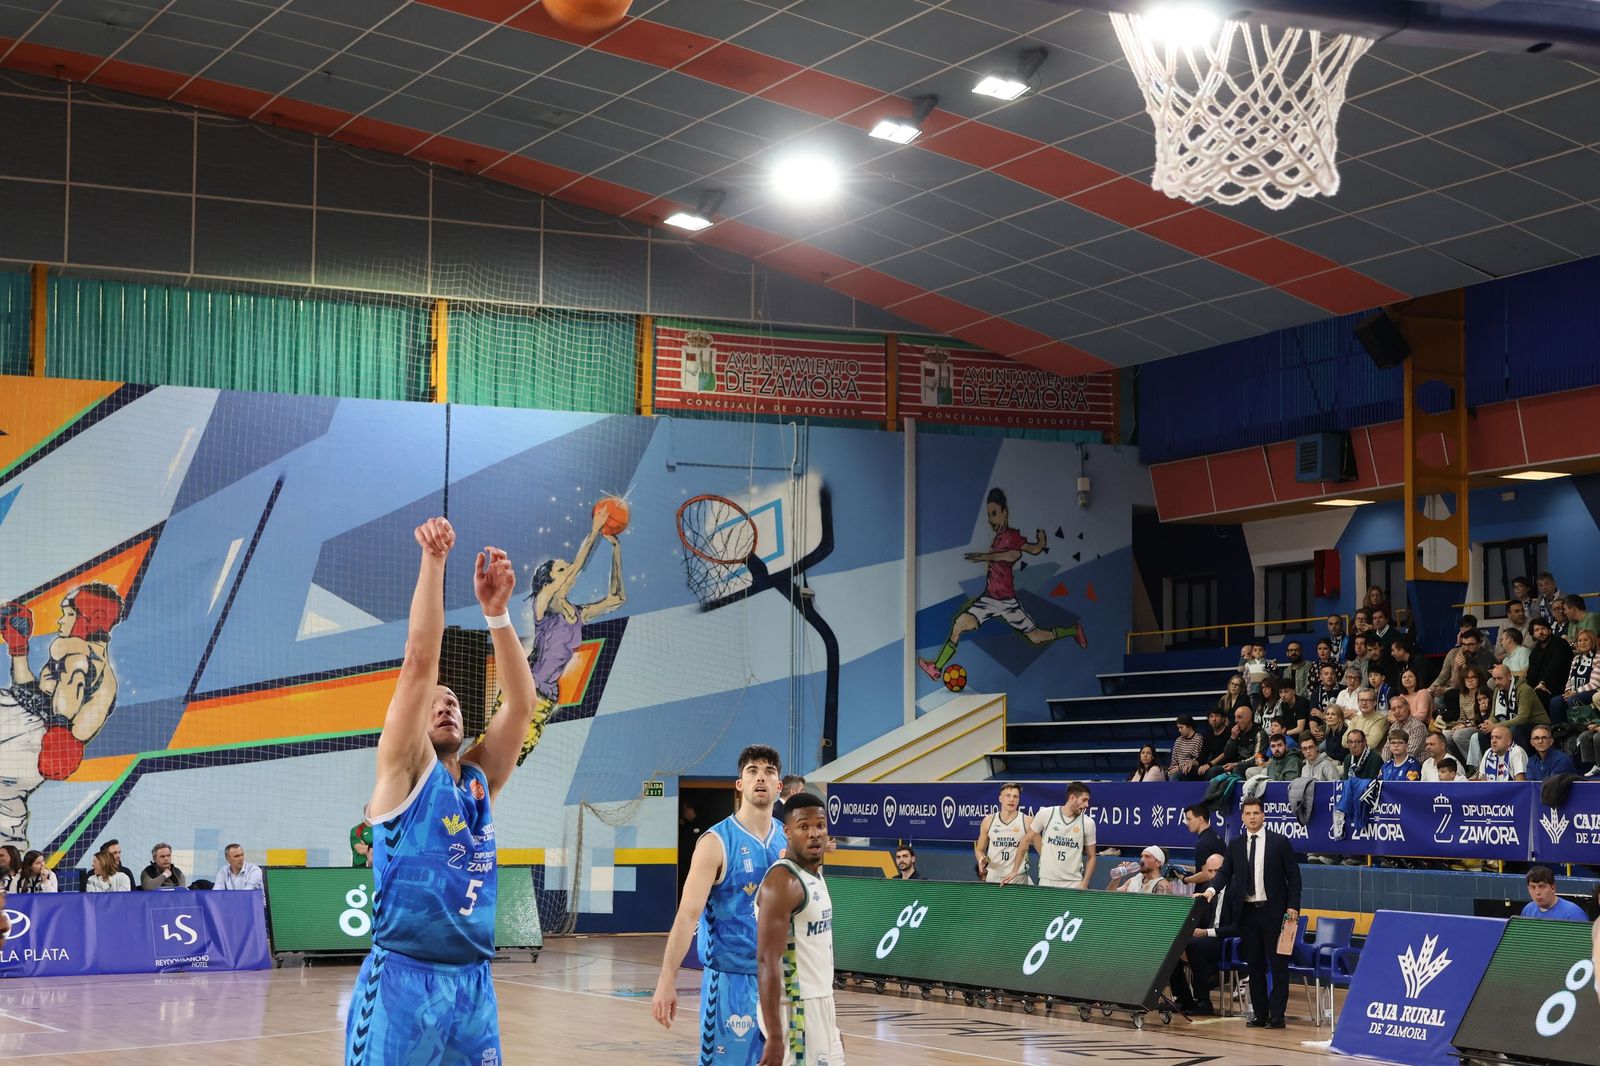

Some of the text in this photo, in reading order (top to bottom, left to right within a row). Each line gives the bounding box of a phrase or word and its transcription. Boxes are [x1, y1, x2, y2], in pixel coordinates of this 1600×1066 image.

[725, 351, 861, 378] AYUNTAMIENTO
[725, 370, 861, 400] DE ZAMORA
[961, 384, 1089, 411] DE ZAMORA
[774, 404, 787, 412] DE
[796, 406, 857, 415] DEPORTES
[1028, 418, 1086, 426] DEPORTES
[843, 803, 999, 817] MORALEJO MORALEJO MORALEJO
[1089, 807, 1142, 825] FADIS
[1459, 825, 1520, 845] ZAMORA
[1575, 832, 1589, 844] DE
[1001, 851, 1010, 861] 10
[1057, 851, 1066, 861] 15
[459, 879, 484, 917] 5
[0, 948, 70, 963] LA PLATA
[1366, 1001, 1446, 1027] CAJA RURAL
[1368, 1022, 1428, 1041] DE ZAMORA
